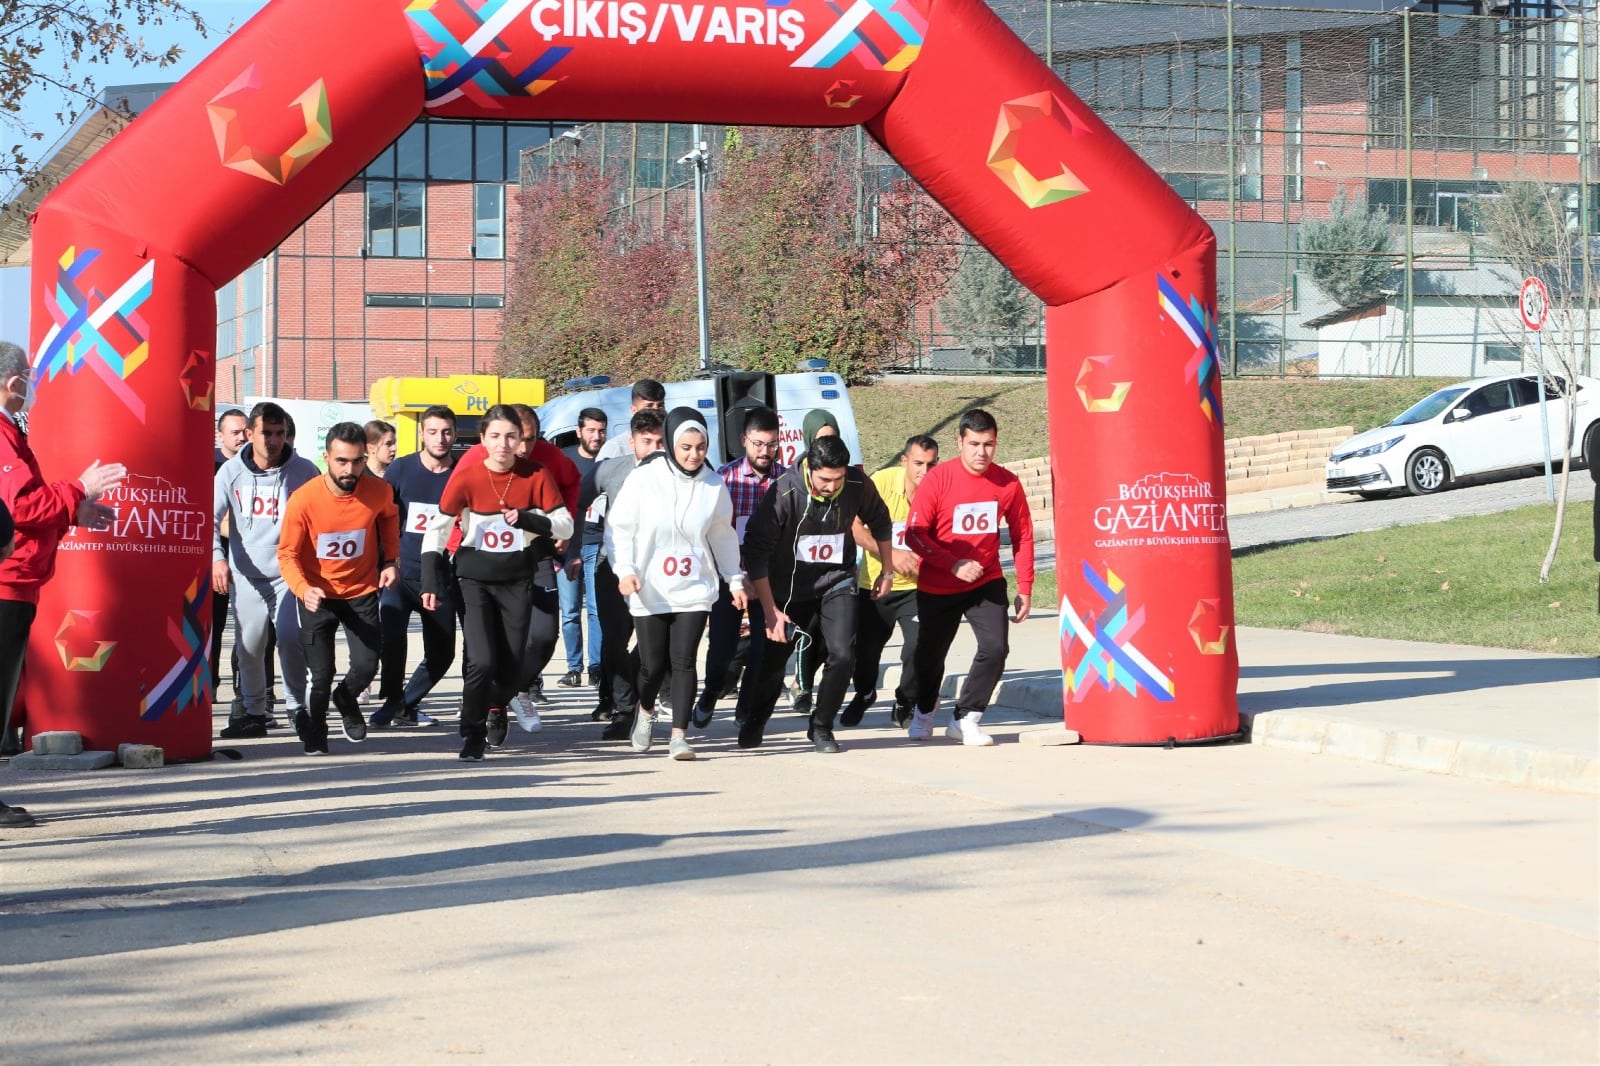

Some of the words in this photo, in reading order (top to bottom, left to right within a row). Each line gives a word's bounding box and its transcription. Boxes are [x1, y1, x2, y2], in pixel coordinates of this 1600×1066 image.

[530, 0, 805, 51] ÇIKIŞ/VARIŞ
[467, 395, 489, 412] Ptt
[97, 486, 188, 505] YÜKŞEHİR
[1119, 481, 1214, 501] BÜYÜKŞEHİR
[252, 496, 279, 516] 02
[414, 513, 436, 531] 2
[961, 513, 989, 531] 06
[1093, 500, 1226, 534] GAZİANTEP
[57, 541, 104, 552] AZİANTEP
[106, 542, 167, 554] BÜYÜKŞEHİR
[326, 539, 357, 558] 20
[484, 530, 515, 550] 09
[1095, 538, 1145, 548] GAZİANTEP
[808, 544, 833, 561] 10
[663, 556, 693, 577] 03
